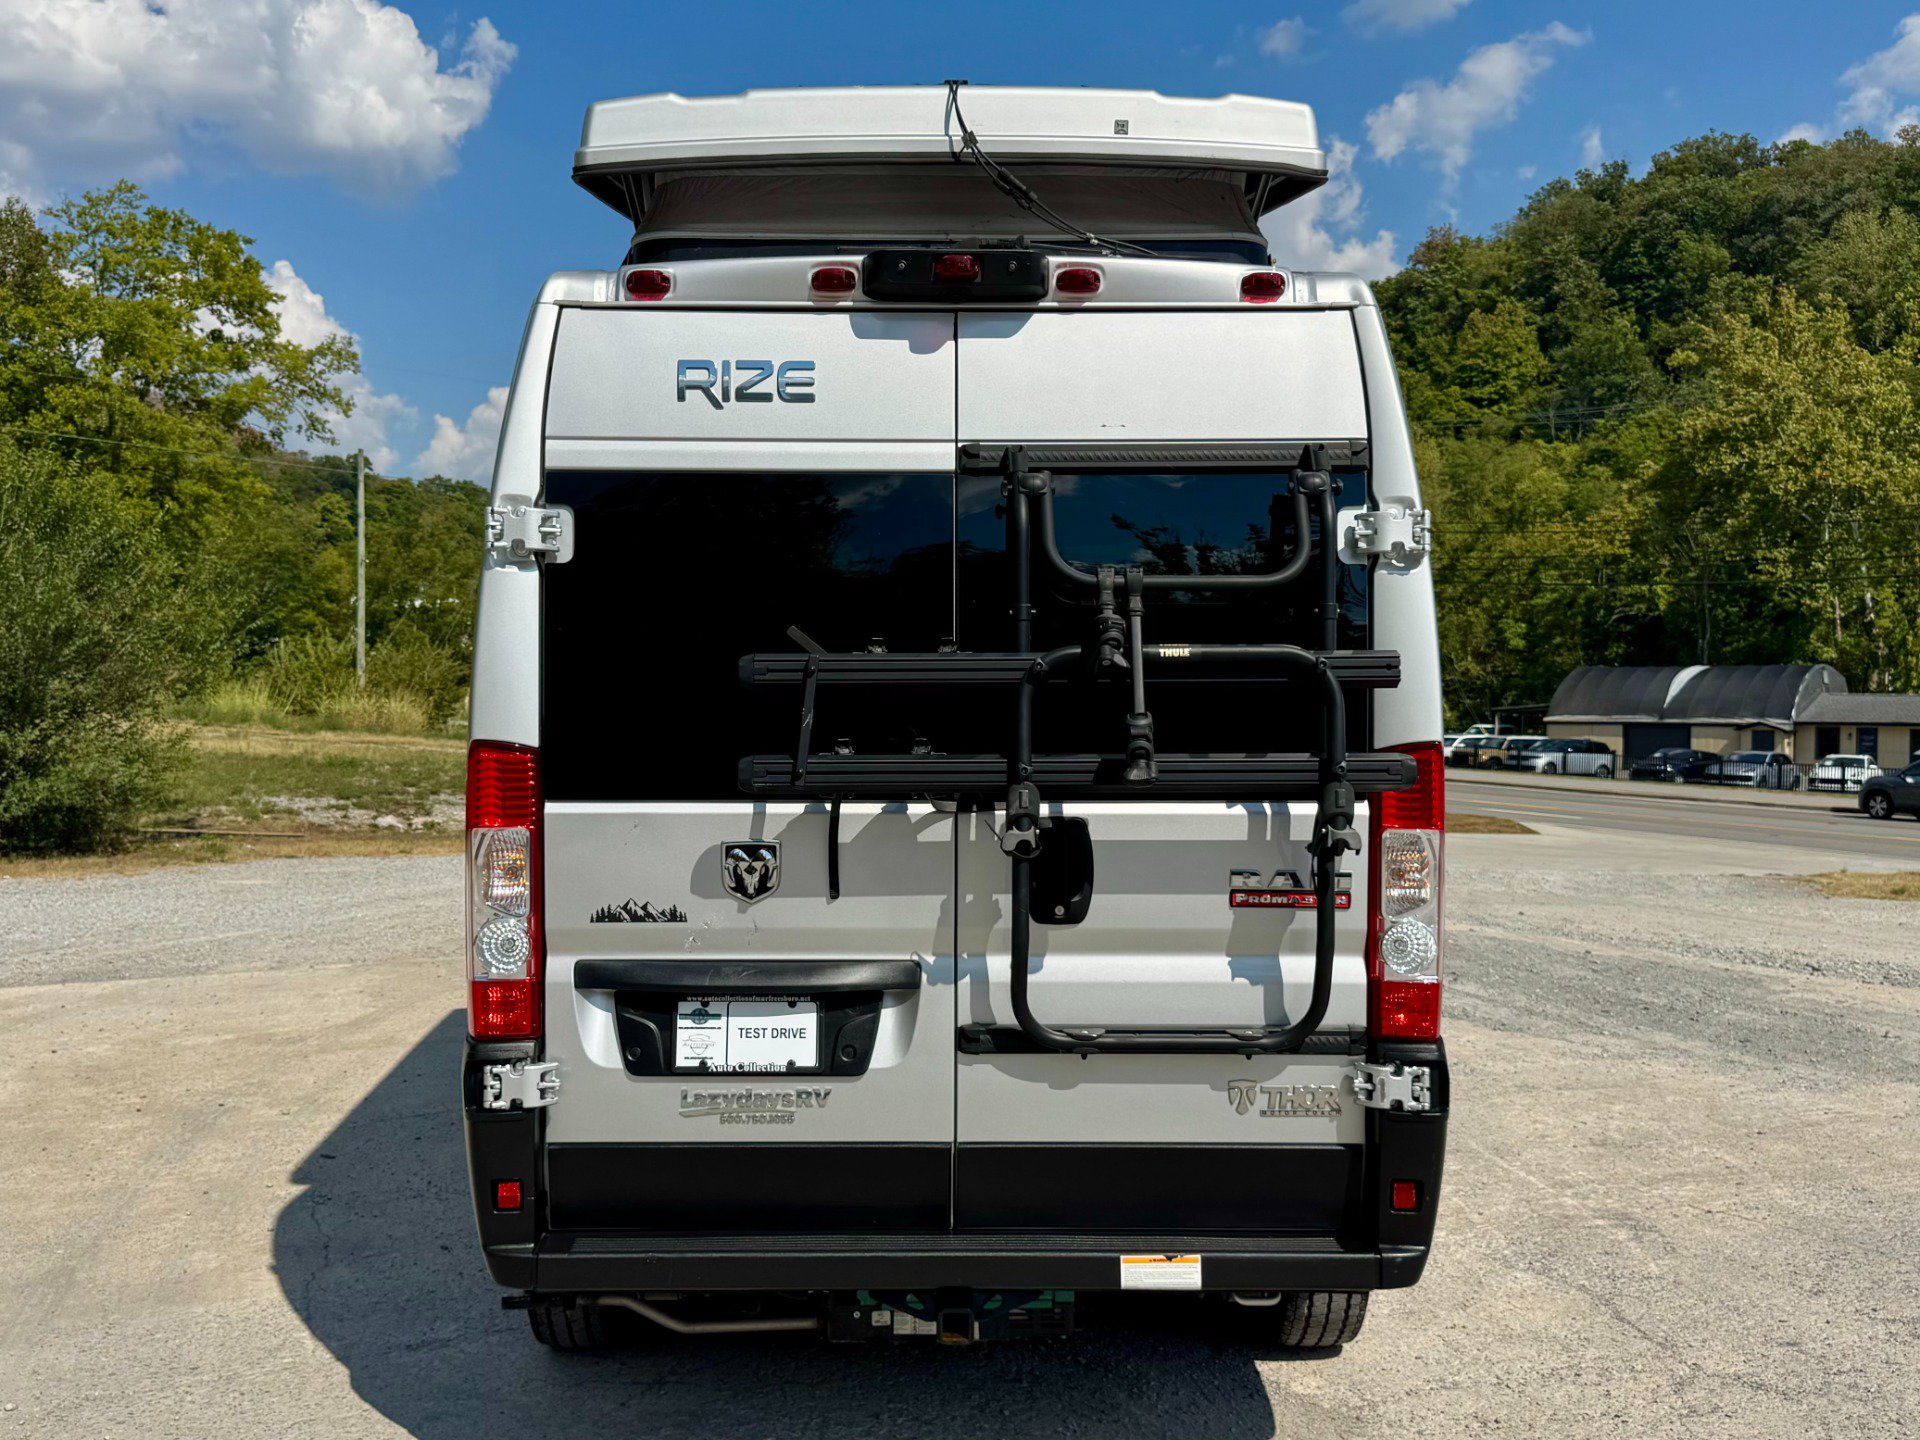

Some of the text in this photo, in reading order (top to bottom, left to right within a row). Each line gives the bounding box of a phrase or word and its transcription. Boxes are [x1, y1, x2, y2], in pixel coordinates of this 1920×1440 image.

[677, 359, 816, 410] RIZE
[1159, 648, 1190, 657] THULE
[737, 1027, 807, 1039] TEST DRIVE
[708, 1061, 787, 1072] Auto Collection
[680, 1086, 832, 1111] LazydaysRV
[1260, 1084, 1342, 1110] THOR
